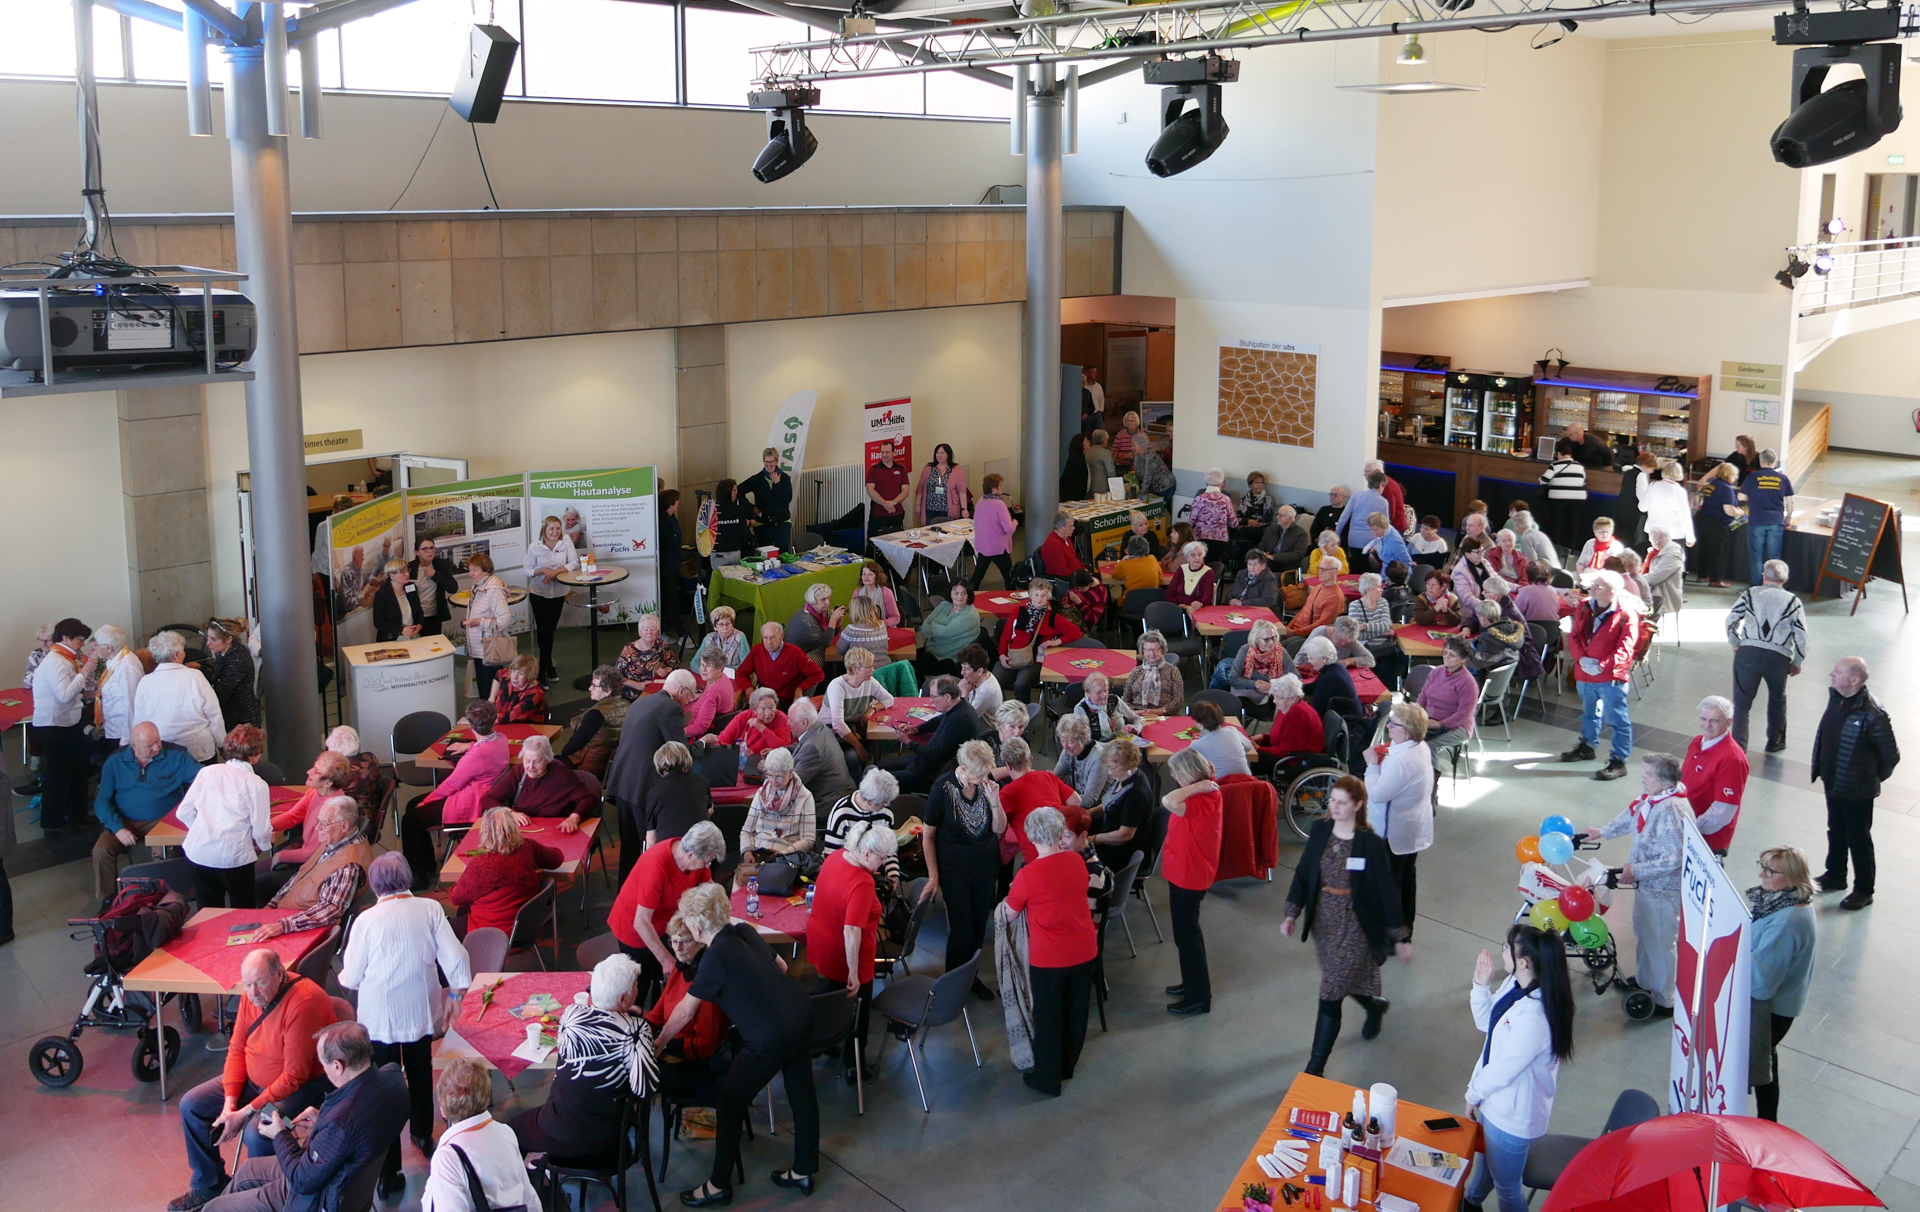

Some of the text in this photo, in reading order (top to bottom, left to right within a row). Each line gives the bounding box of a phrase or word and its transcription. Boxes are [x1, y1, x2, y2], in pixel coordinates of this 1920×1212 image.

[1238, 340, 1270, 349] Stuhlpaten
[1414, 355, 1449, 370] Bar
[1738, 365, 1765, 374] Garderobe
[1654, 375, 1698, 393] Bar
[1735, 381, 1766, 390] Kleiner Saal
[324, 437, 348, 446] theater
[540, 480, 593, 490] AKTIONSTAG
[573, 486, 632, 497] Hautanalyse
[412, 500, 434, 508] Unsere
[435, 494, 473, 505] Leidenschaft
[478, 491, 495, 499] Gutes
[496, 487, 520, 496] Wohnen
[610, 545, 631, 553] Fuchs
[391, 673, 450, 690] WOHNBAUTEN SCHWEDT
